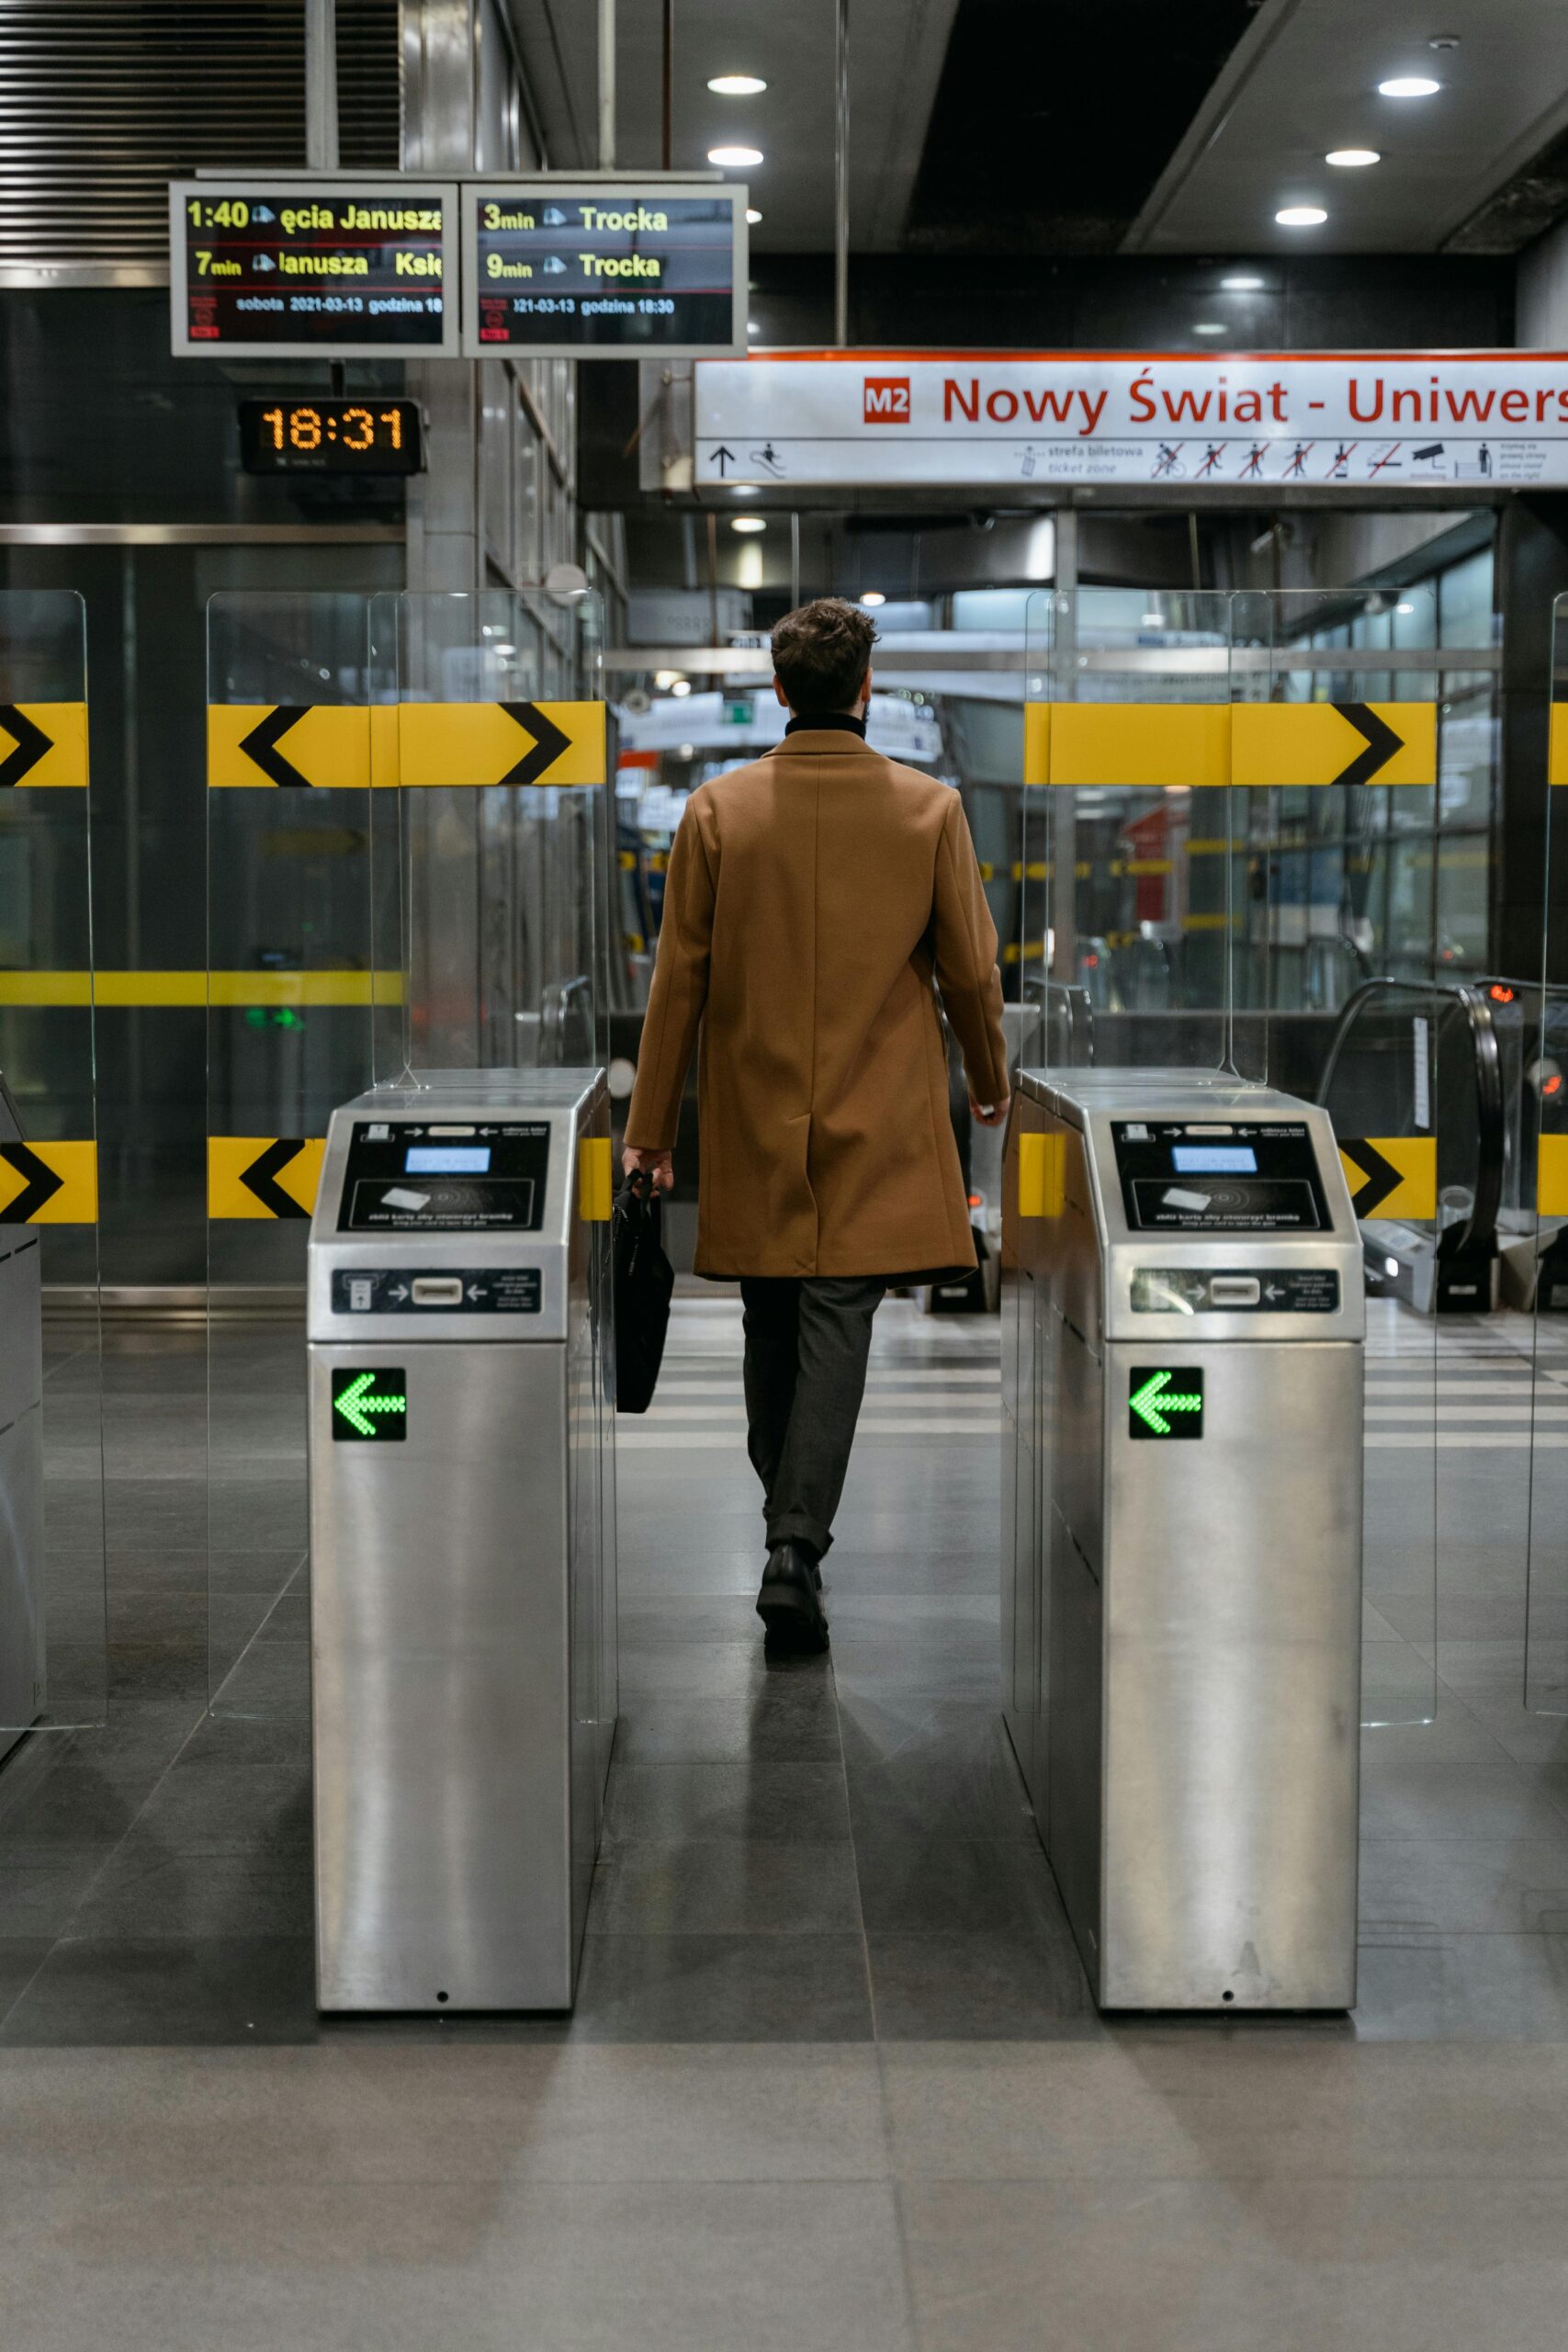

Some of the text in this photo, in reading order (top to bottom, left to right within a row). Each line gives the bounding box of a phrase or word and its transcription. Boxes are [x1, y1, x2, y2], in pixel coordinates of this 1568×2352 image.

[186, 200, 250, 229] 1:40
[279, 204, 334, 234] ęcia
[578, 206, 669, 232] Trocka
[578, 253, 661, 277] Trocka
[235, 296, 285, 311] sobota
[289, 297, 365, 312] 2021-03-13
[367, 297, 424, 316] godzina
[580, 298, 636, 317] godzina
[637, 298, 675, 314] 18:30
[864, 387, 909, 413] M2
[942, 378, 1109, 436] Nowy
[1128, 367, 1290, 424] Świat
[262, 407, 402, 450] 18:31
[1048, 443, 1144, 457] strefa biletowa
[1048, 461, 1117, 474] ticket zone
